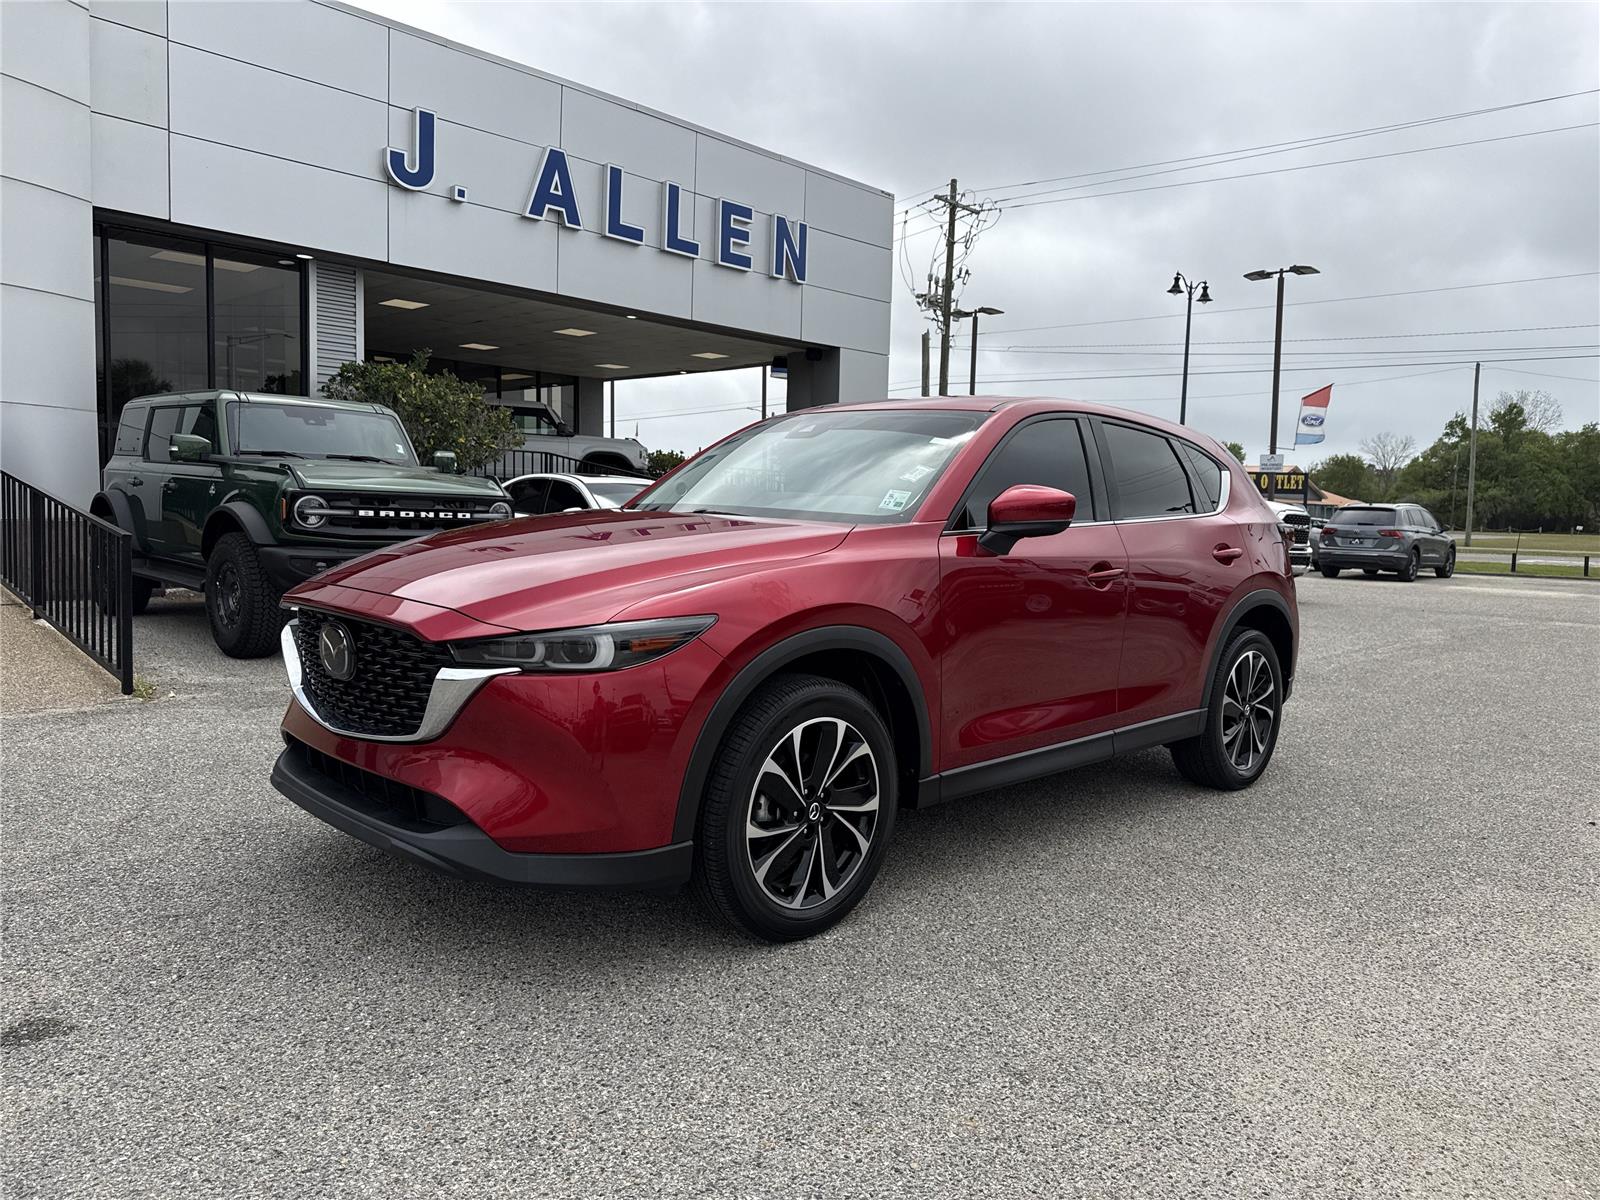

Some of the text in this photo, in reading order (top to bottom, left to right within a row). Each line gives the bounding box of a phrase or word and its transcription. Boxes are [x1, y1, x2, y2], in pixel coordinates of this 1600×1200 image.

[382, 106, 808, 284] J. ALLEN
[1304, 415, 1322, 425] Ford
[1260, 473, 1305, 490] OTLET
[358, 509, 471, 519] BRONCO
